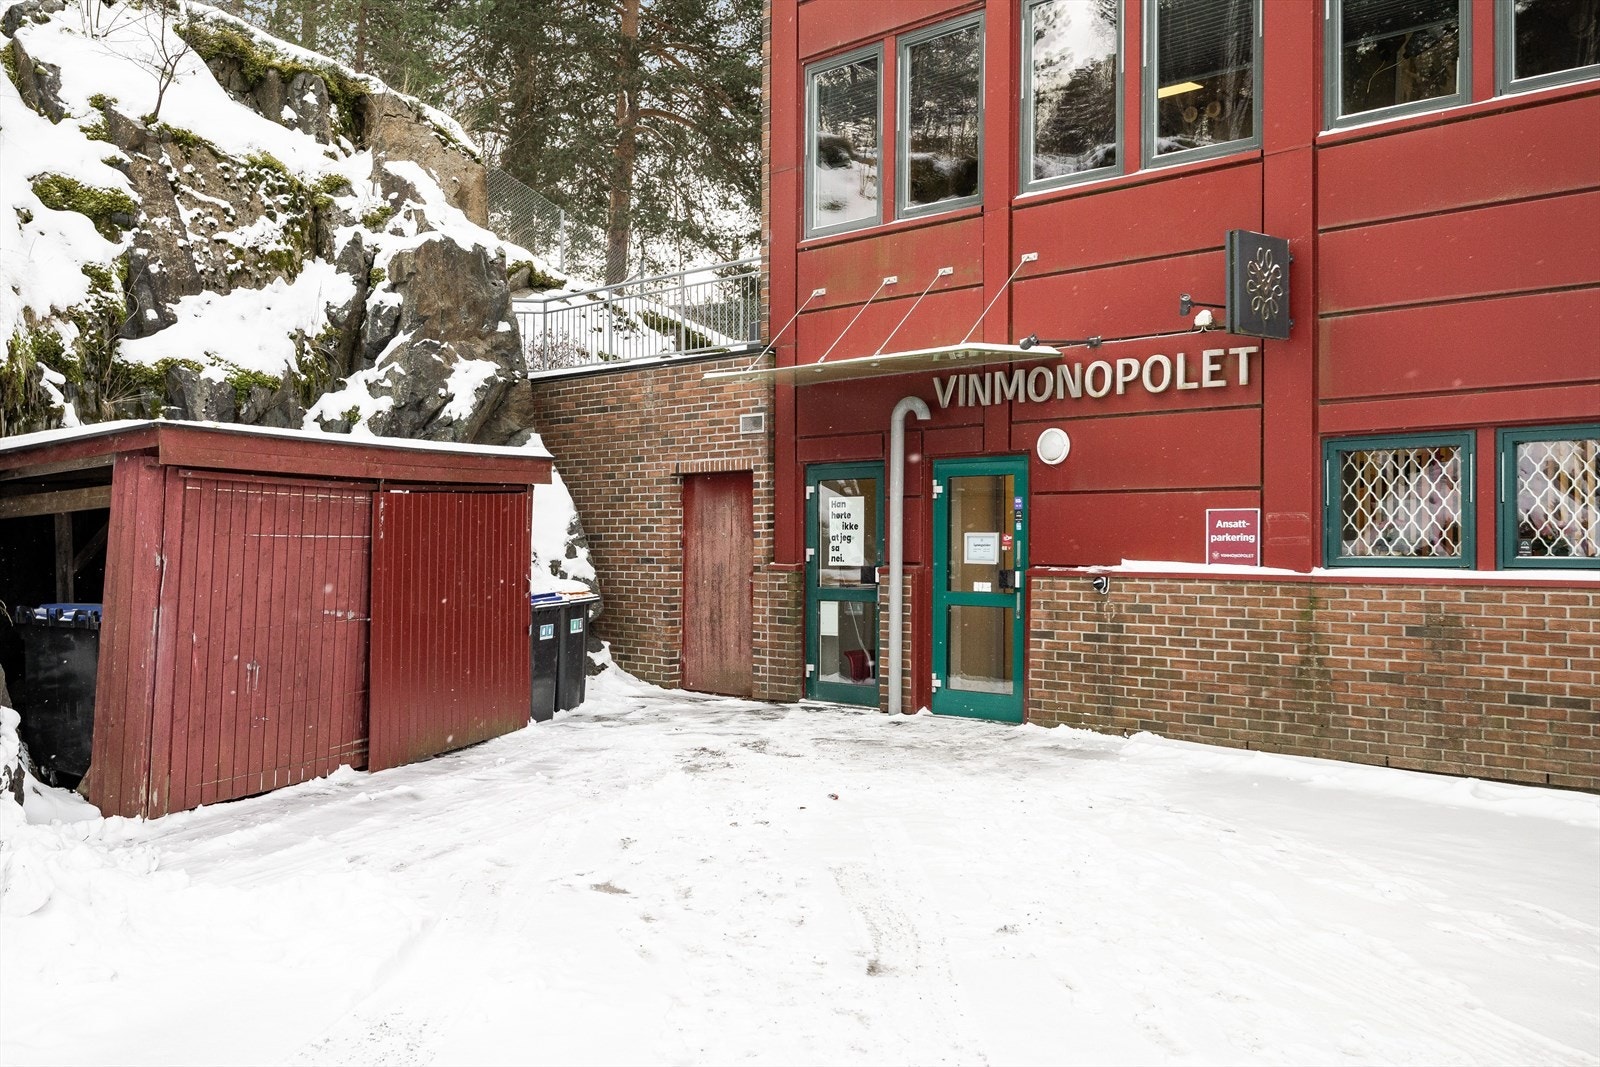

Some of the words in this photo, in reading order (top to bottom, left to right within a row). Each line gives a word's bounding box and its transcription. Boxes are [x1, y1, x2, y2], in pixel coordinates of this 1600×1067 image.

[932, 345, 1259, 409] VINMONOPOLET
[831, 500, 846, 508] Han
[842, 521, 858, 530] ikke
[1215, 519, 1251, 528] Ansatt-
[831, 533, 839, 541] at
[840, 532, 852, 544] jeg
[1210, 532, 1256, 543] parkering
[831, 553, 845, 562] nei.
